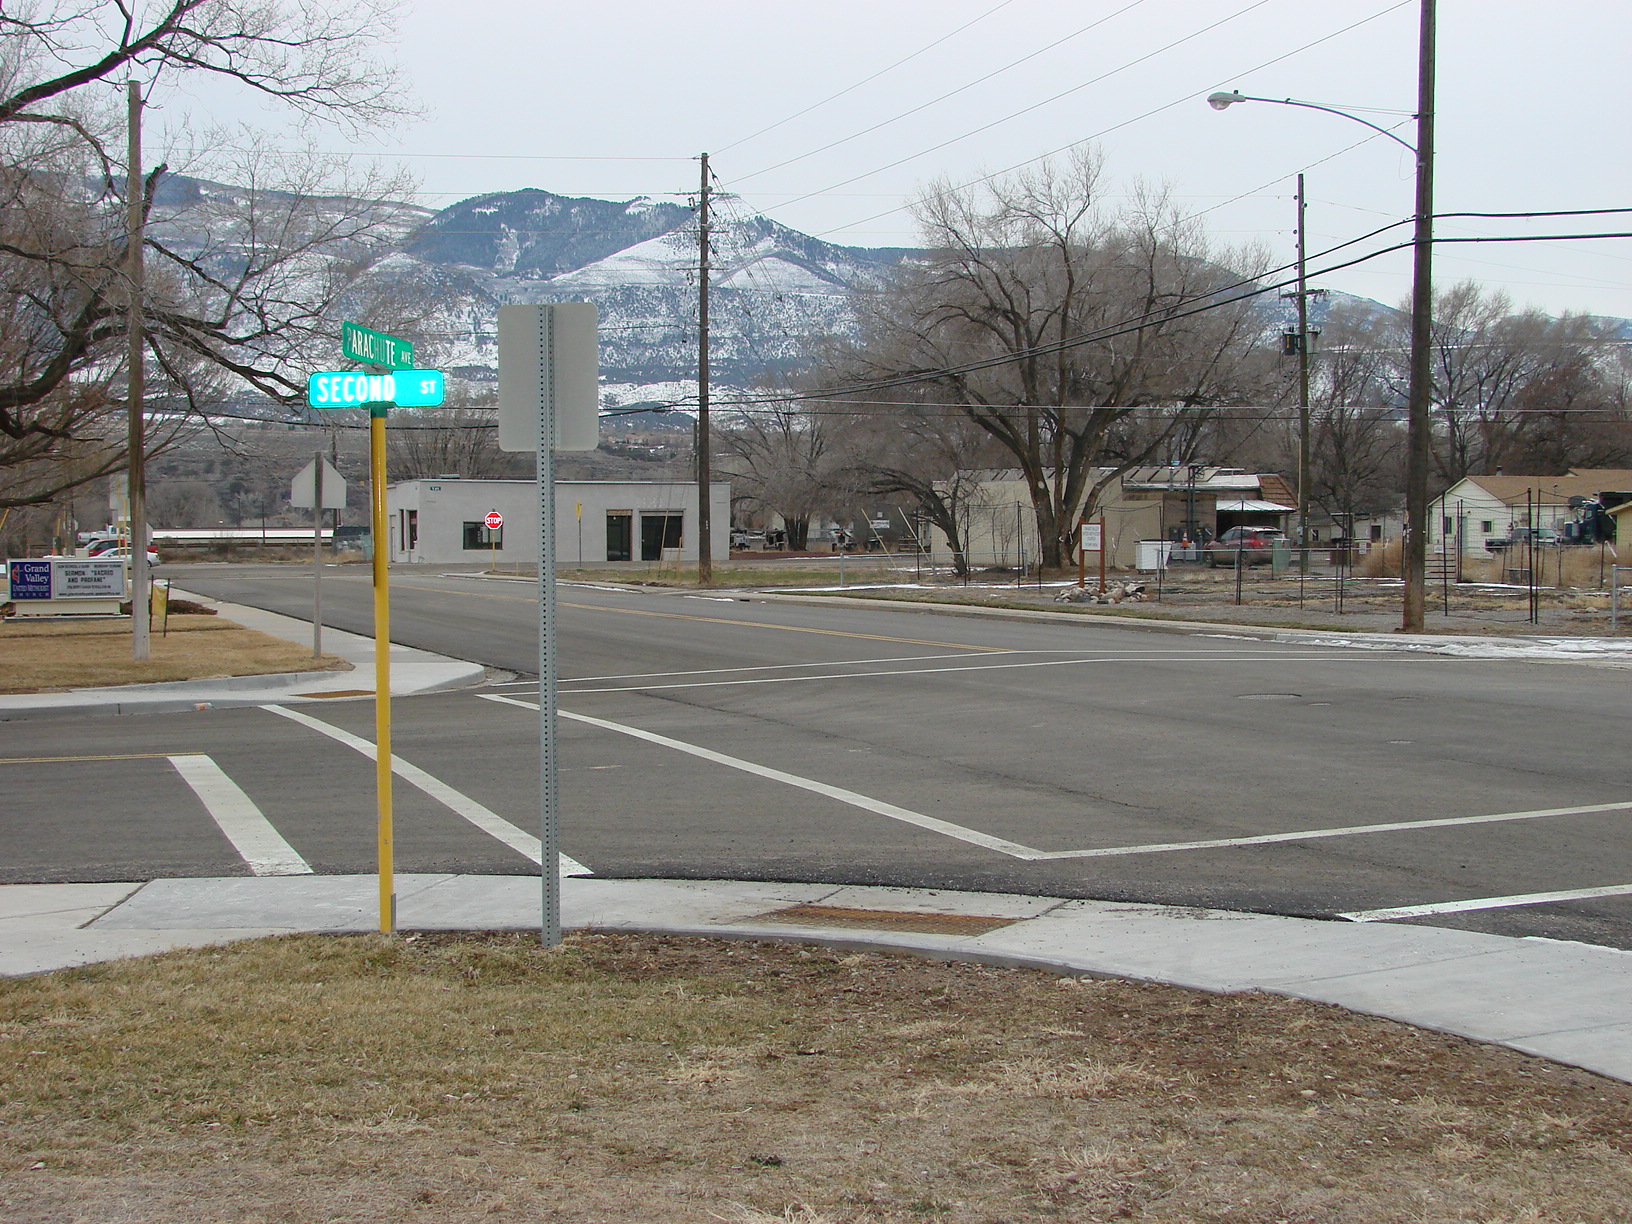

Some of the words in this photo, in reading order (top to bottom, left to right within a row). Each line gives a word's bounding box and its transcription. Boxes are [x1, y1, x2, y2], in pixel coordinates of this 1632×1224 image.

[400, 351, 412, 365] AVE
[317, 375, 396, 402] SECOND
[420, 380, 436, 394] ST
[24, 564, 49, 573] Grand
[25, 574, 49, 584] Valley
